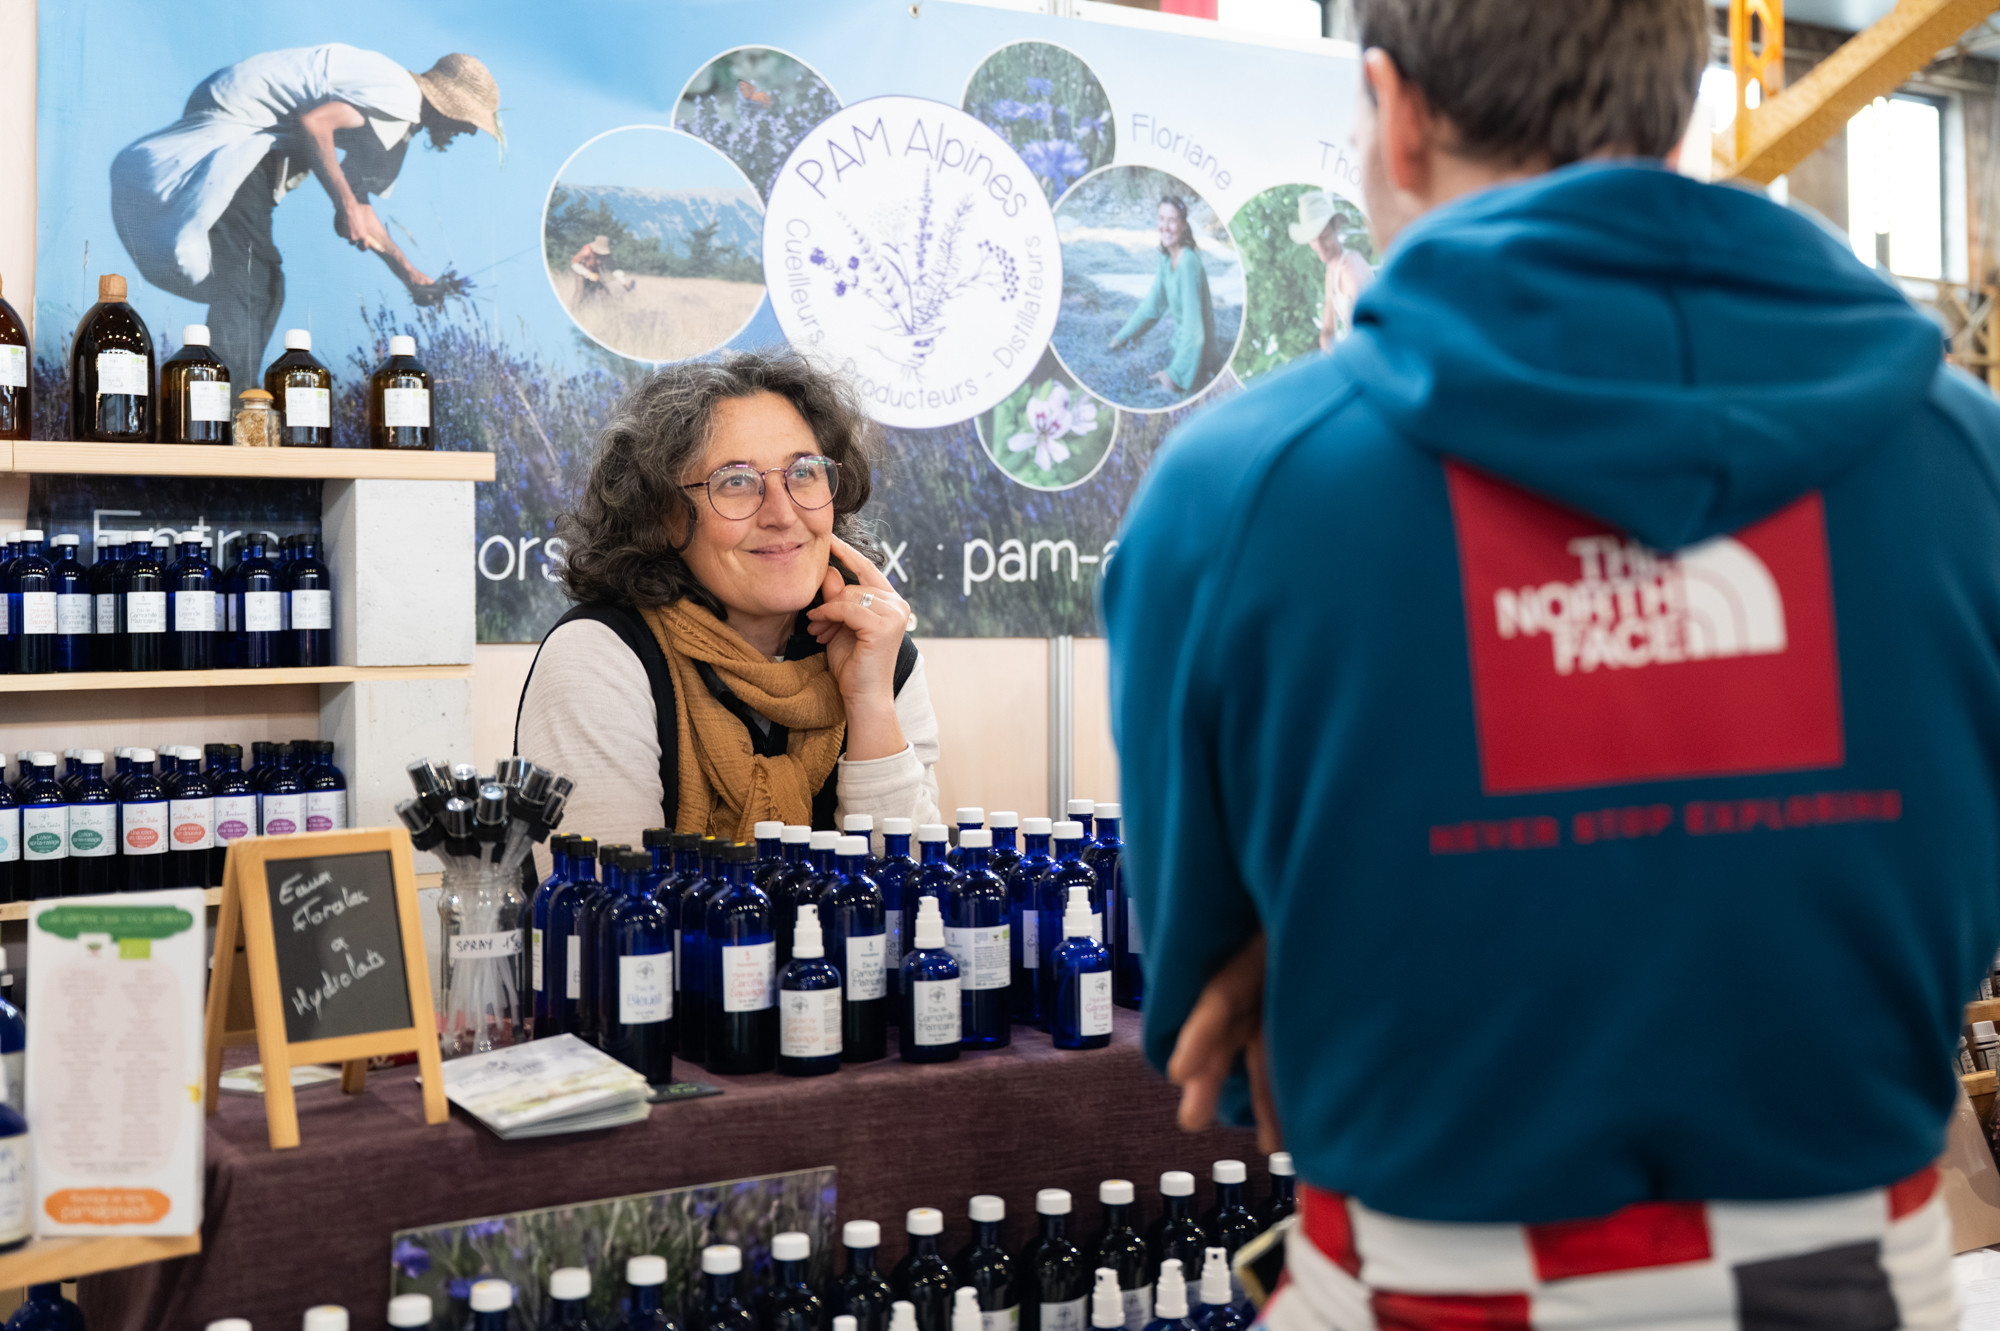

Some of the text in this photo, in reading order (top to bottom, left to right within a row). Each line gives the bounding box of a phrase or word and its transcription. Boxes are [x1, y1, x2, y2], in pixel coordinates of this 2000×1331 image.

[796, 117, 1028, 218] PAM Alpines
[1131, 113, 1232, 191] Floriane
[993, 235, 1044, 369] Distillateurs
[456, 939, 493, 953] SPRAY
